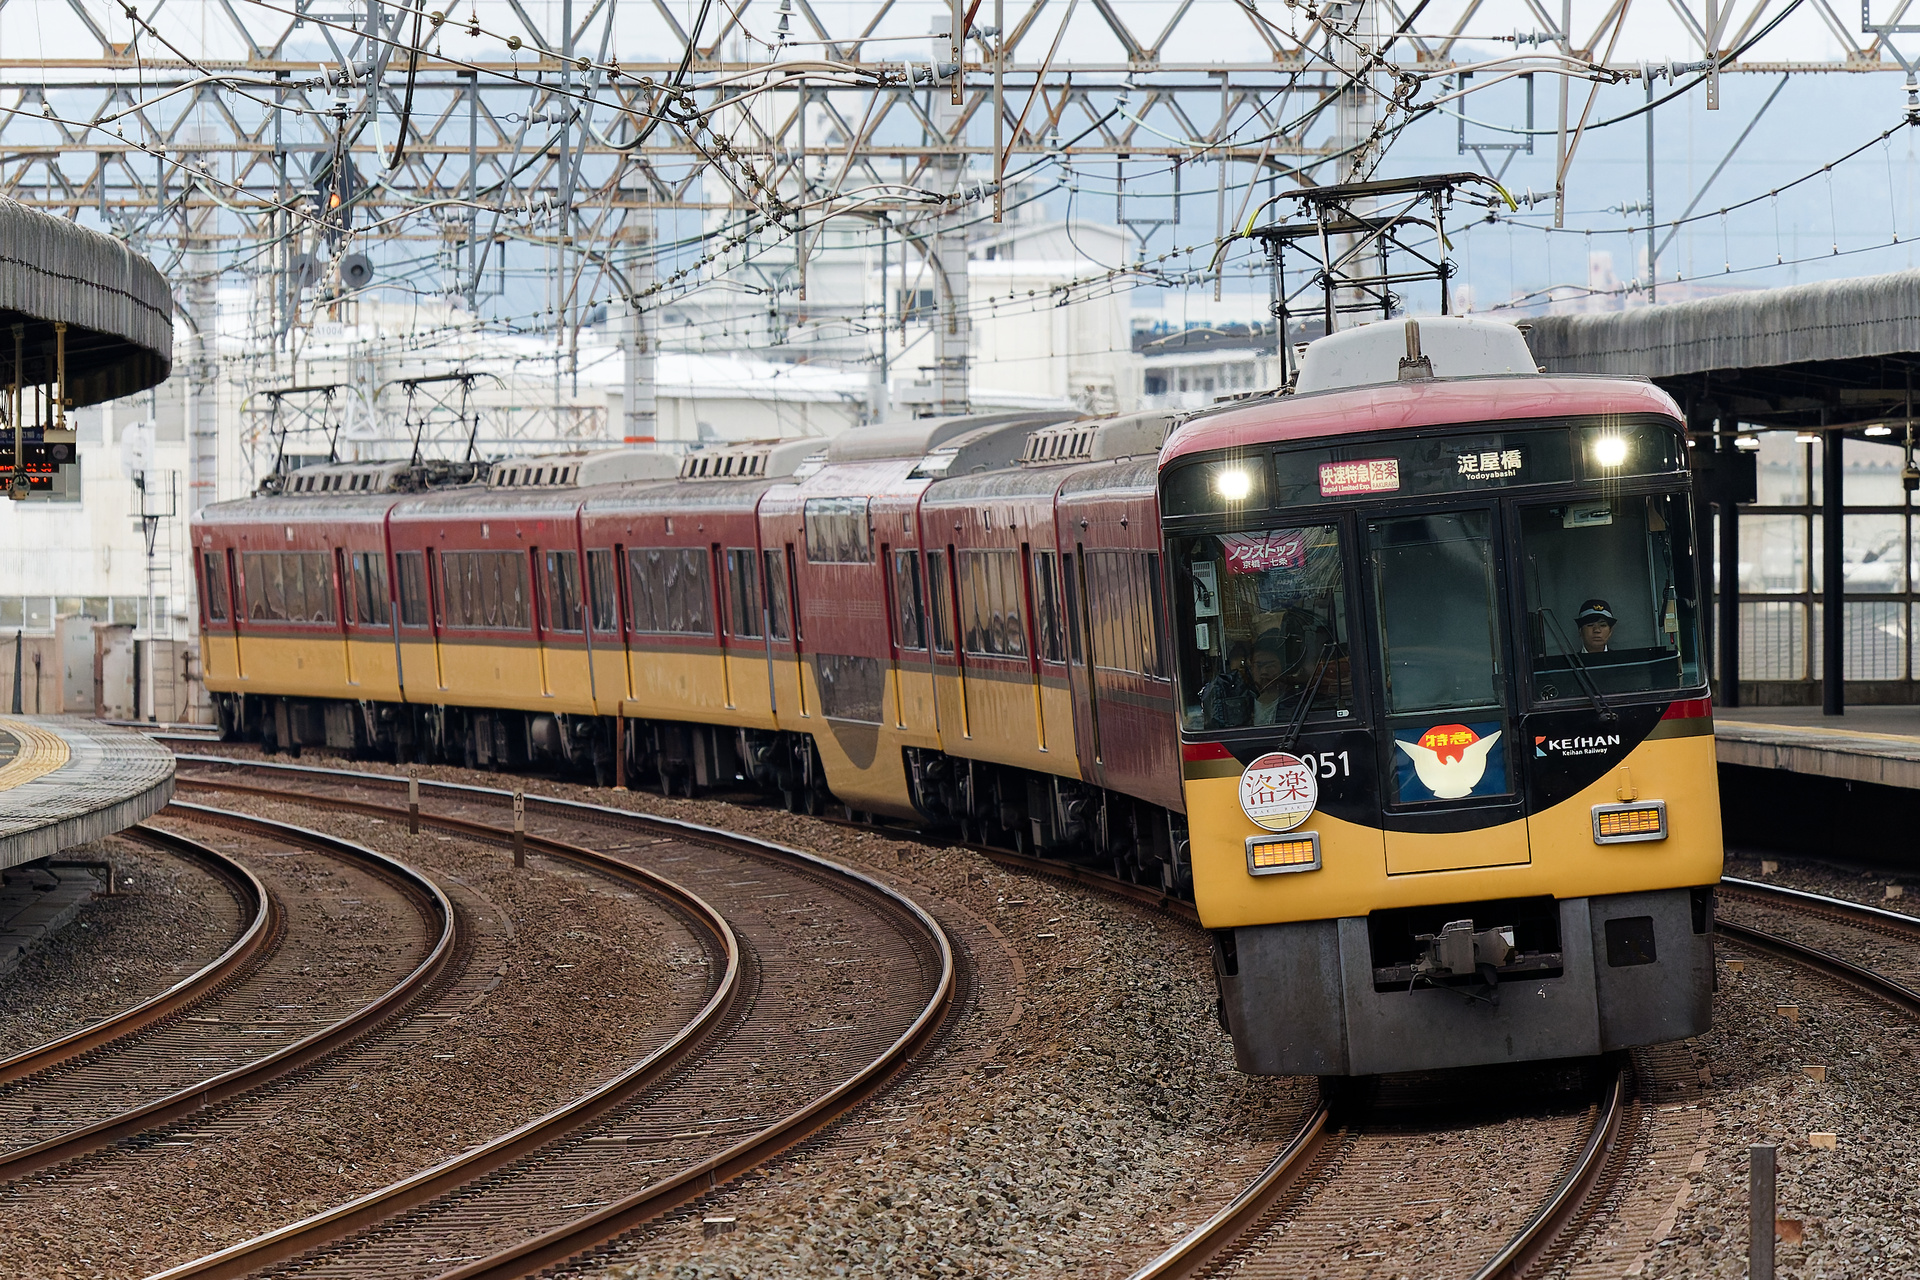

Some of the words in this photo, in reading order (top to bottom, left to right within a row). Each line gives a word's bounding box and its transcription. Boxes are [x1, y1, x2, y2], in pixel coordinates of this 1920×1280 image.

[1457, 449, 1522, 475] 淀屋橋
[1321, 463, 1370, 486] 快速特急
[1371, 461, 1398, 481] 洛楽
[1465, 469, 1516, 480] Yodoyabashi
[1339, 484, 1359, 492] Limited
[1229, 540, 1299, 561] ノンストップ
[1425, 731, 1473, 747] 特急
[1548, 734, 1620, 751] KEIHAN
[1562, 748, 1583, 756] Keihan
[410, 768, 417, 778] 8
[1245, 770, 1309, 805] 洛楽
